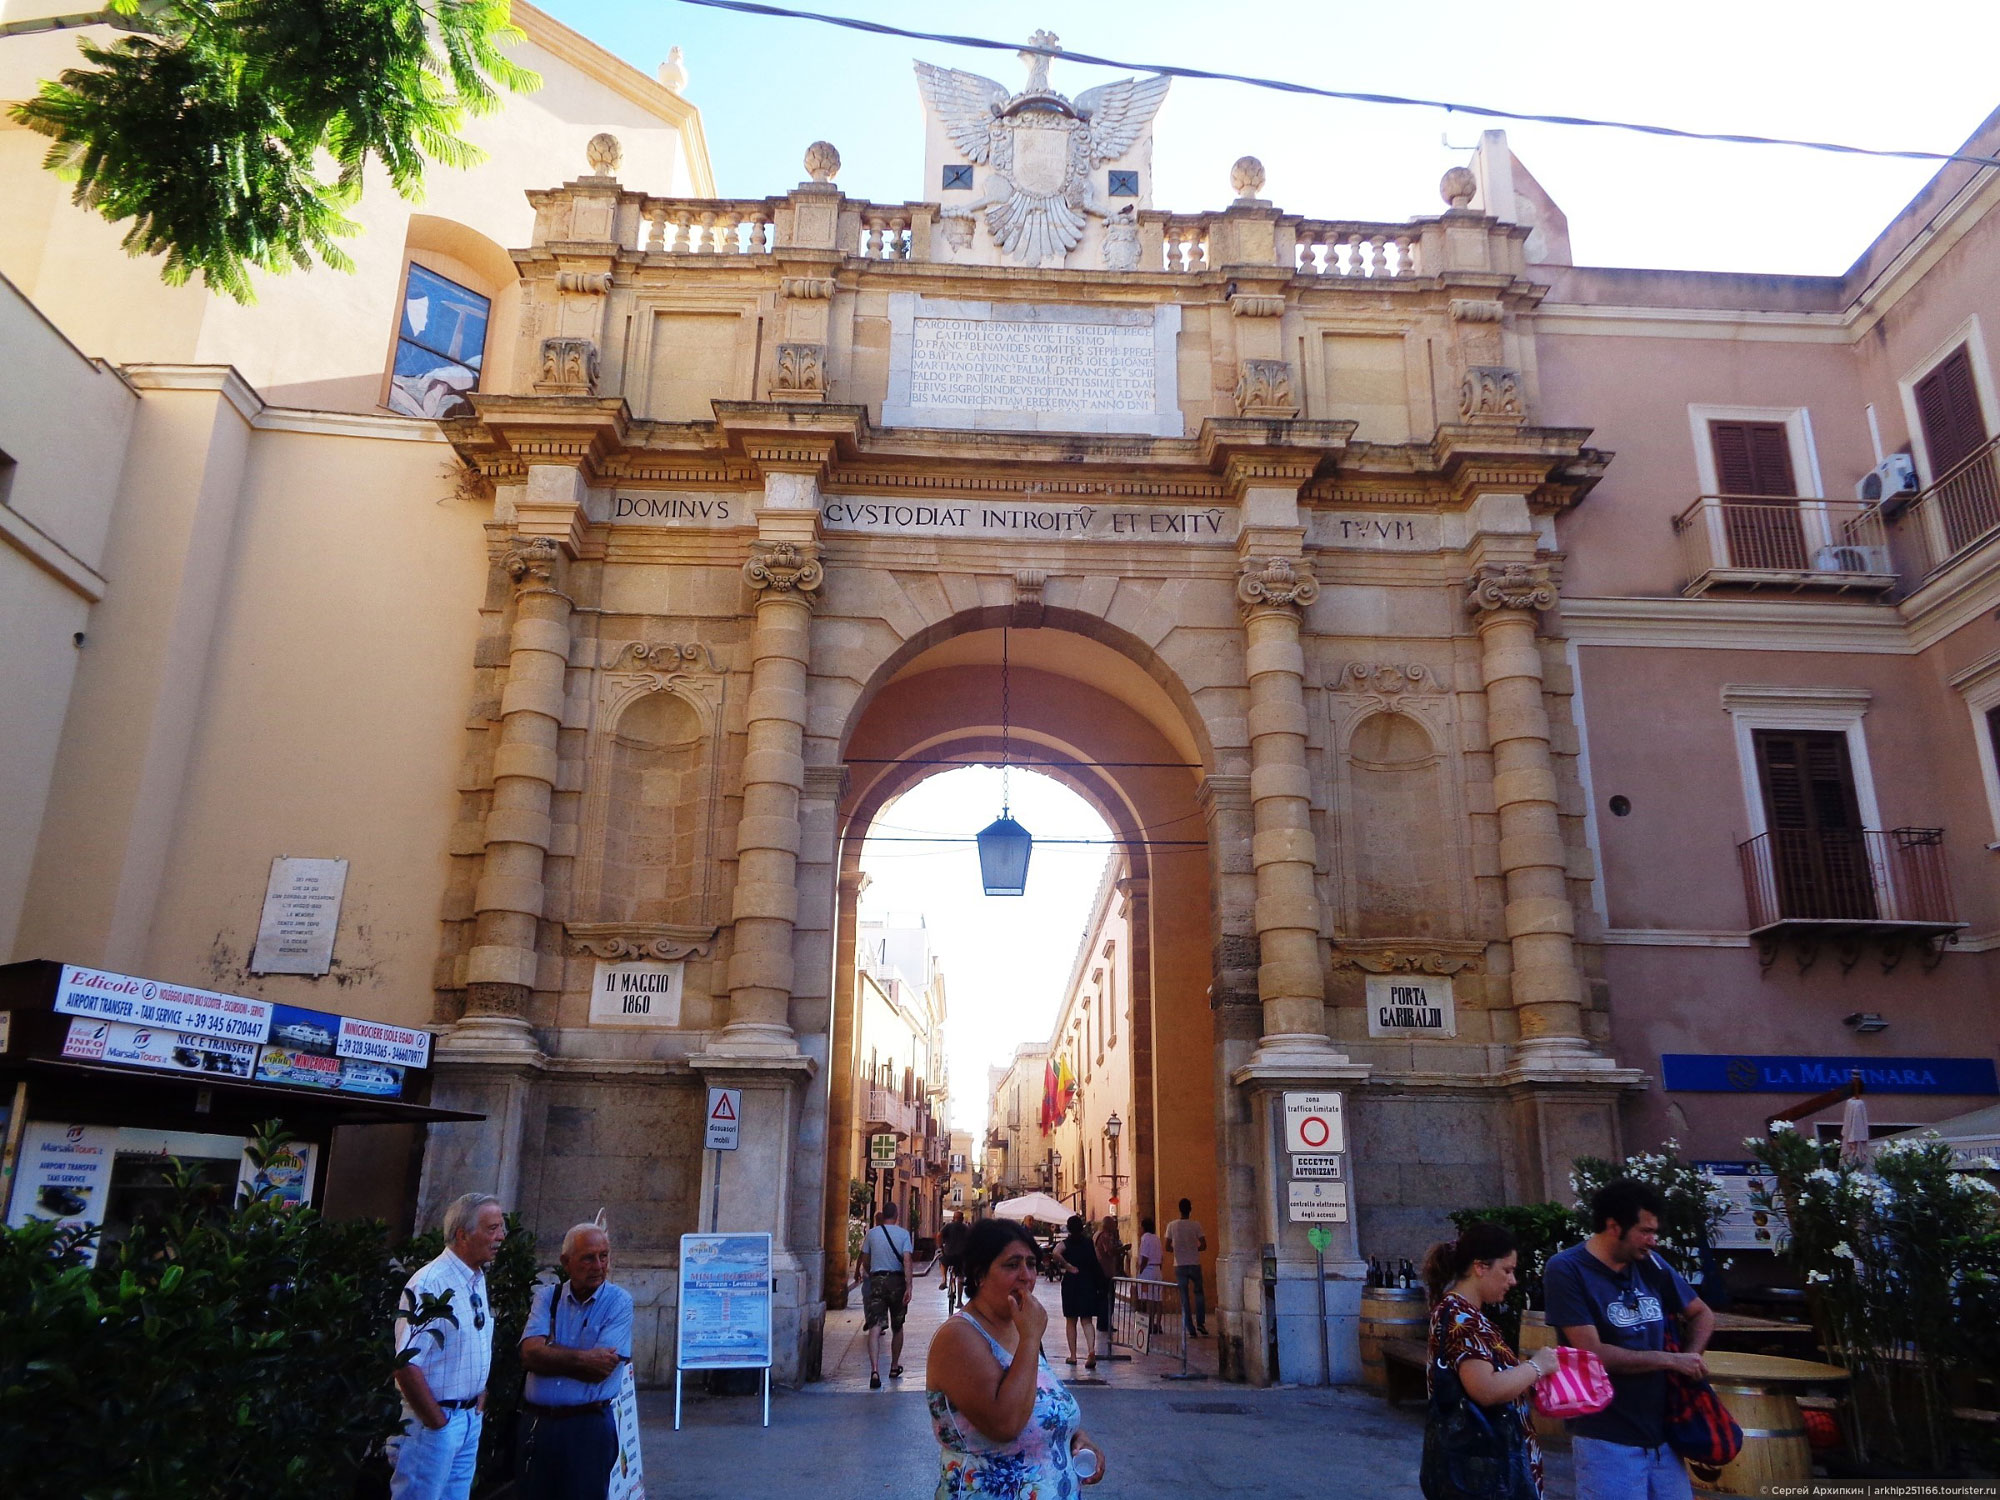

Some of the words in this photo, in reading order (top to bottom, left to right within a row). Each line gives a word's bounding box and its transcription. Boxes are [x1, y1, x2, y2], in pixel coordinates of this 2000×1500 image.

[915, 321, 960, 331] CAROLO
[1058, 326, 1071, 334] ET
[936, 332, 1003, 341] CATHOLICO
[1007, 334, 1020, 342] AC
[1024, 334, 1105, 346] INVICTISSIMO
[970, 342, 1030, 353] BENAVIDES
[967, 352, 1027, 363] CARDINALE
[913, 361, 973, 371] MARTIANO
[913, 372, 946, 381] FALDO
[1034, 386, 1077, 397] PORTAM
[912, 393, 928, 402] BIS
[932, 394, 1022, 406] MAGNIFICENTIAM
[1026, 397, 1088, 408] EREXERVNT
[1091, 400, 1124, 409] ANNO
[616, 498, 729, 519] DOMINVS
[826, 504, 970, 526] CVSTODIAT
[1112, 513, 1141, 533] ET
[70, 971, 139, 995] Edicolè
[621, 974, 669, 992] MAGGIO
[1391, 987, 1427, 1006] PORTA
[623, 995, 650, 1013] 1860
[65, 992, 99, 1010] AIRPORT
[99, 998, 133, 1017] TRANSFER
[140, 1005, 155, 1020] TAXI
[156, 1008, 183, 1024] SERVICE
[185, 1013, 206, 1028] +39
[207, 1016, 224, 1032] 345
[225, 1019, 263, 1038] 6720447
[1379, 1007, 1442, 1027] GARIBALDI
[67, 1037, 103, 1047] INFO
[177, 1034, 197, 1046] NCC
[199, 1038, 204, 1047] E
[208, 1039, 254, 1054] TRANSFER
[64, 1045, 101, 1056] POINT
[1763, 1067, 1795, 1084] LA
[710, 1124, 736, 1133] dissuasori
[67, 1163, 98, 1172] TRANSFER
[1298, 1158, 1334, 1166] ECCETTO
[1296, 1167, 1337, 1176] AUTORIZZATI
[47, 1174, 60, 1182] TAXI
[62, 1175, 86, 1183] SERVICE
[1290, 1200, 1315, 1208] controllo
[695, 1281, 728, 1289] Favignana
